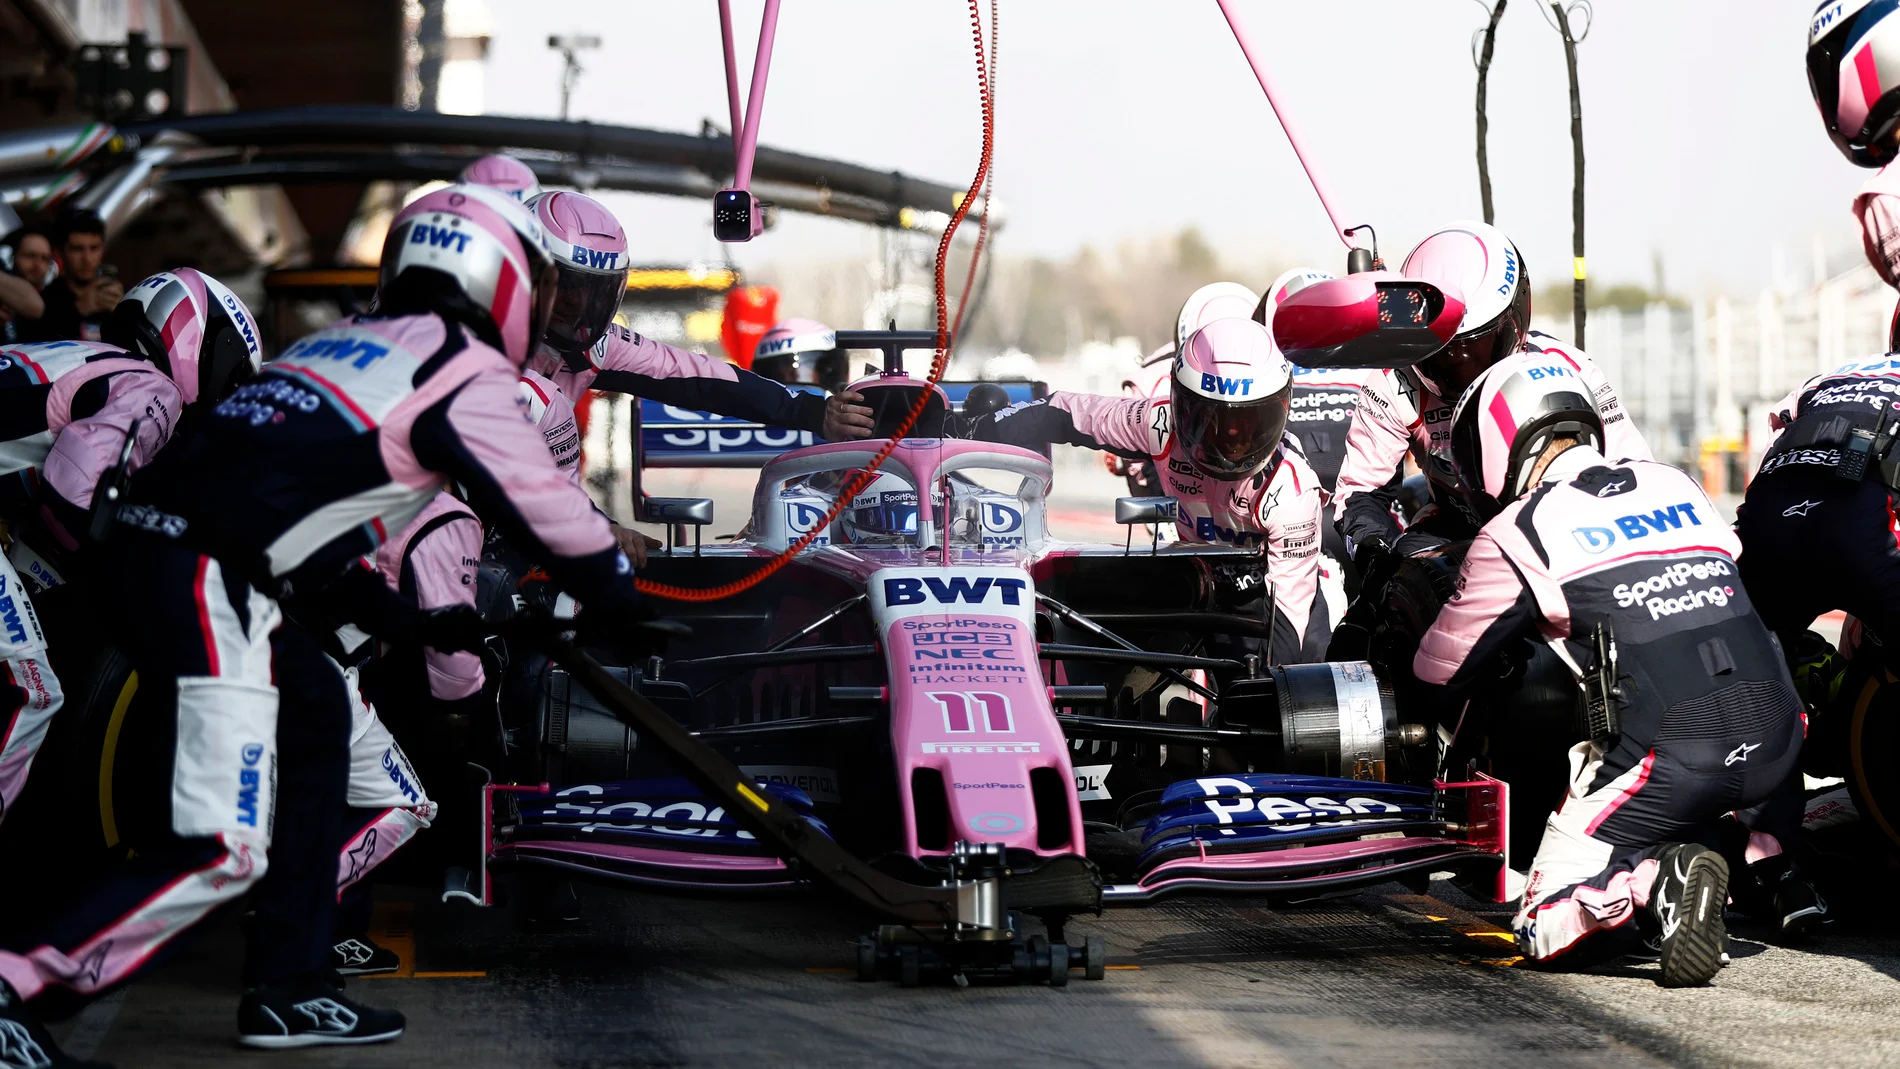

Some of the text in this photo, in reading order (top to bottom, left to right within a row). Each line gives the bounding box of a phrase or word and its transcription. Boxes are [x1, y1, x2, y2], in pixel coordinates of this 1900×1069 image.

[1813, 3, 1844, 36] BWT
[411, 224, 472, 254] BWT
[572, 245, 619, 270] BWT
[1505, 247, 1516, 286] BWT
[234, 311, 259, 355] BWT
[759, 337, 794, 355] BWT
[1201, 372, 1253, 396] BWT
[1527, 366, 1574, 381] BWT
[1290, 393, 1360, 409] ortPesa
[860, 496, 878, 506] BWT
[1614, 502, 1702, 540] BWT
[884, 576, 1026, 607] BWT
[1613, 560, 1732, 608] SportPesa
[1645, 586, 1728, 621] Racing
[0, 595, 28, 644] BWT
[903, 619, 1017, 631] SportPesa
[912, 631, 1013, 646] JCB
[909, 662, 1026, 673] infinitum
[915, 648, 1016, 660] NEC
[923, 690, 1017, 734] 11
[921, 741, 1041, 754] PIRELLI
[237, 768, 261, 828] BWT
[389, 764, 420, 804] BWT
[953, 782, 1025, 790] SportPesa
[1196, 777, 1402, 835] Pesa
